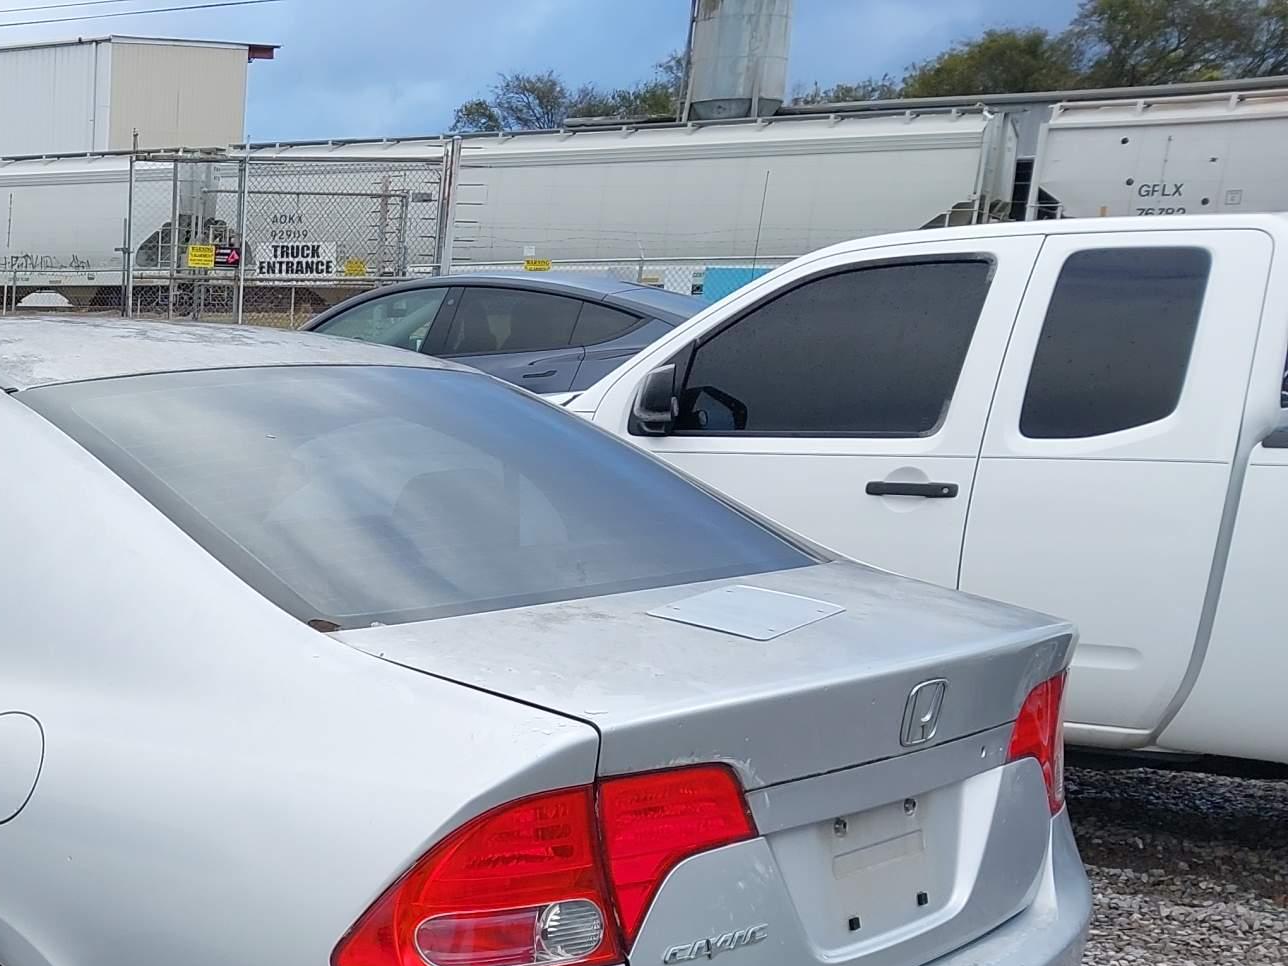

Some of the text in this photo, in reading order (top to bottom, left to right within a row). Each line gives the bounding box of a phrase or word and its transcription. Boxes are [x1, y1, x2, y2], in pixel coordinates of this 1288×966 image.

[1138, 183, 1185, 198] GFLX
[271, 244, 321, 259] TRUCK
[258, 260, 333, 275] ENTRANCE
[662, 922, 769, 965] CIVIC
